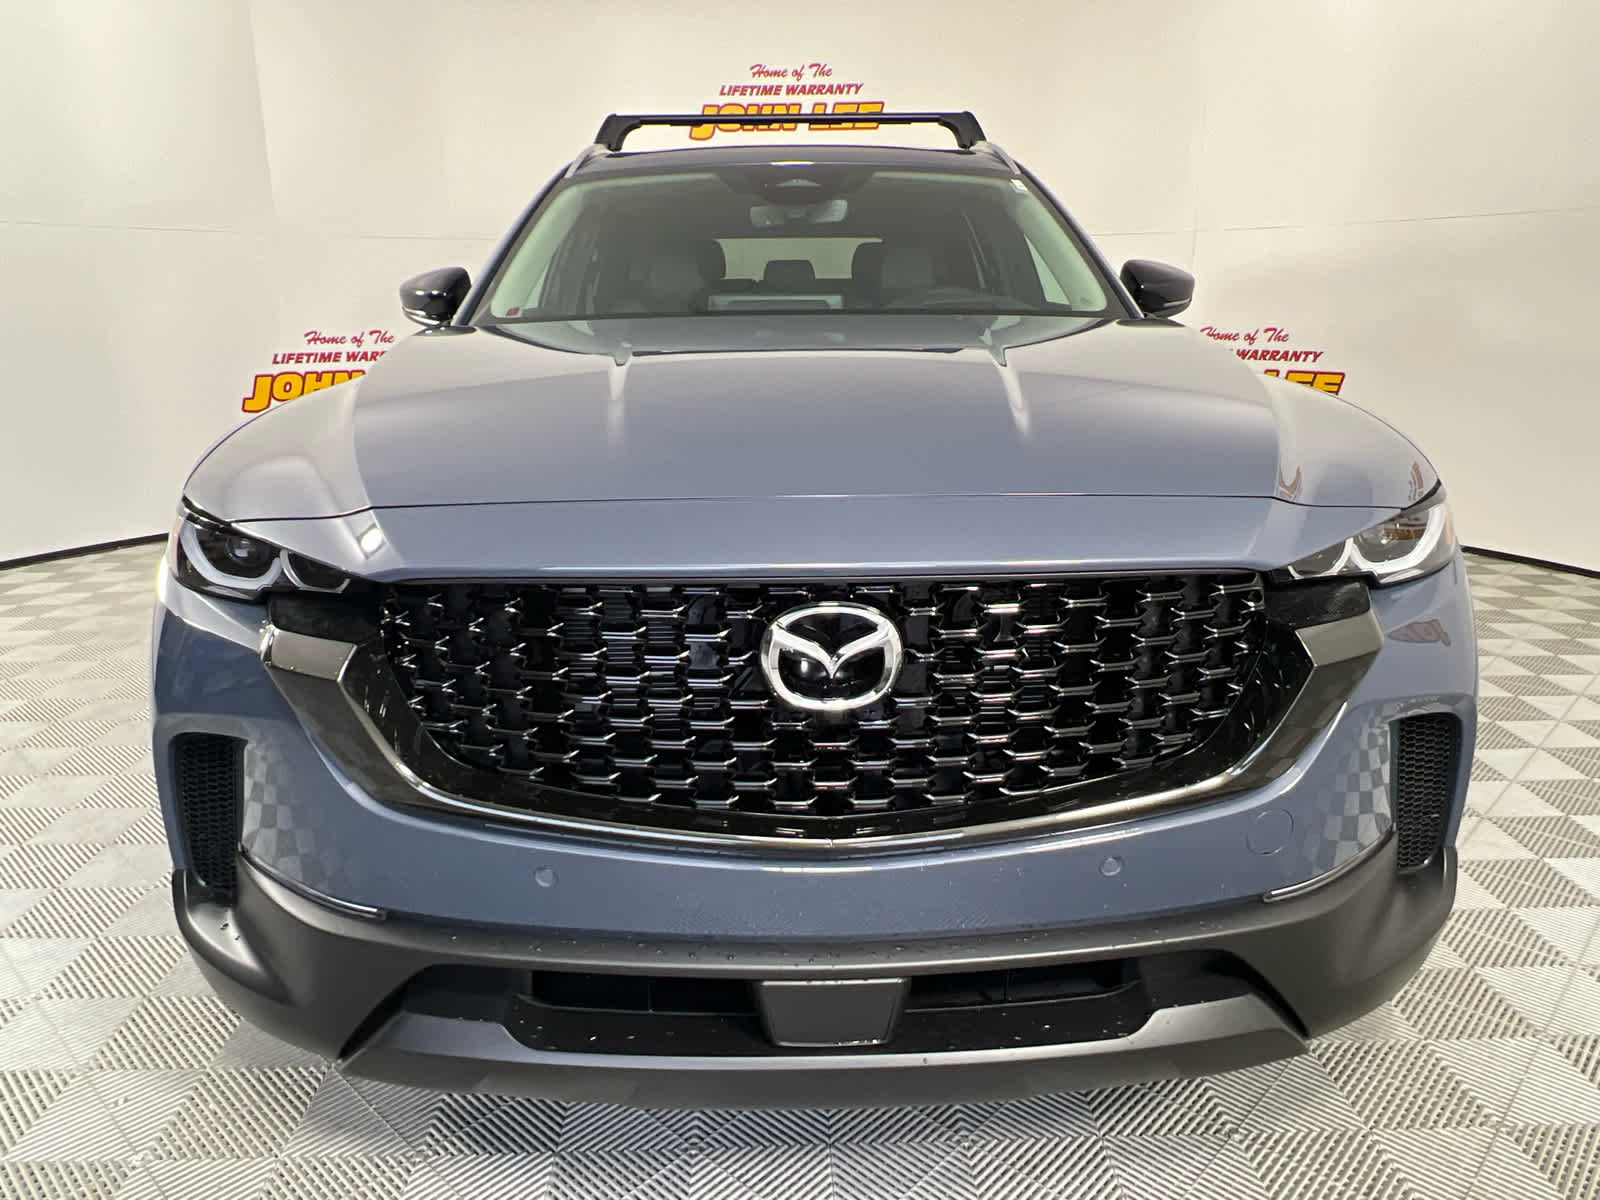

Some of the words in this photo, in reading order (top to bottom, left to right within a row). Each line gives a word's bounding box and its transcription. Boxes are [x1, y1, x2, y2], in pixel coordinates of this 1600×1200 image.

[750, 63, 788, 78] Home
[791, 65, 804, 80] of
[808, 63, 832, 77] The
[719, 84, 782, 96] LIFETIME
[785, 83, 863, 95] WARRANTY
[304, 330, 346, 344] Home
[350, 332, 364, 348] of
[369, 329, 395, 344] The
[1243, 328, 1259, 345] of
[1264, 327, 1289, 342] The
[272, 352, 341, 364] LIFETIME
[1236, 348, 1323, 362] WARRANTY
[242, 370, 366, 413] JOH
